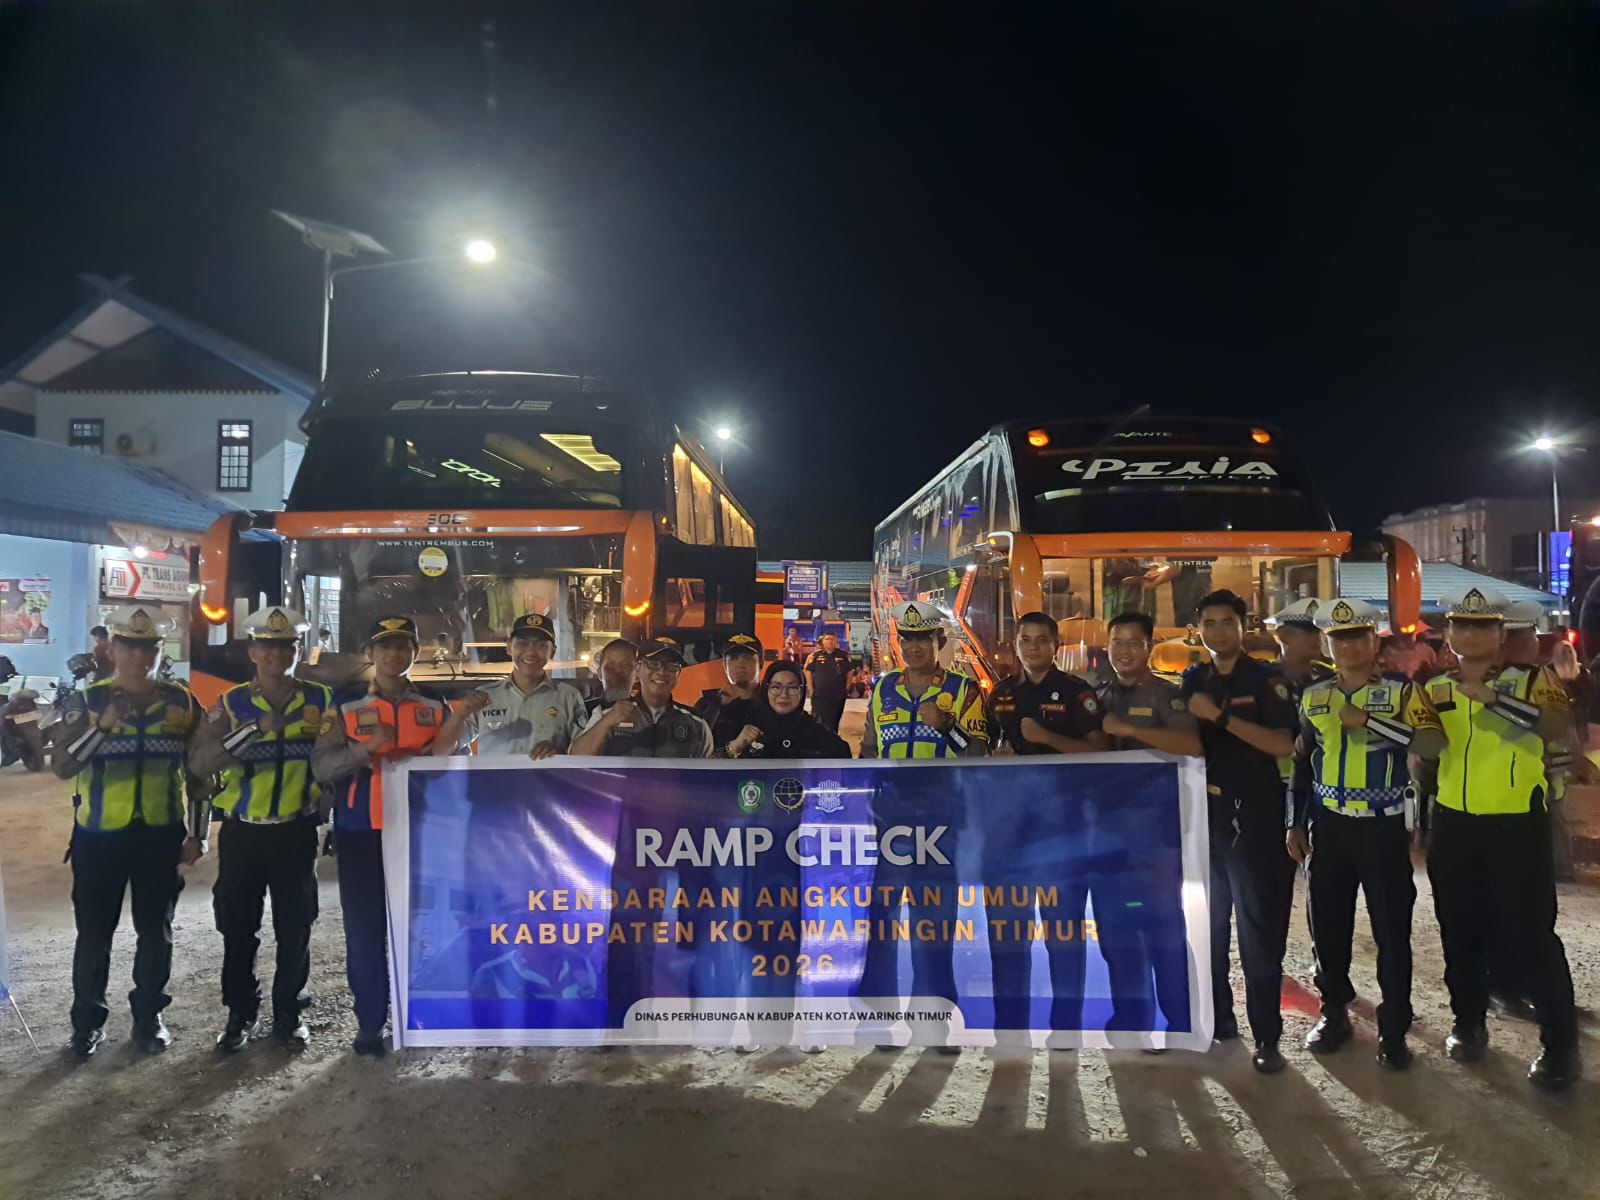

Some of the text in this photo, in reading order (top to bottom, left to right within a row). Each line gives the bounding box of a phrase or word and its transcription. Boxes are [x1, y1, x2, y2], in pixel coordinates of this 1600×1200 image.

[482, 709, 507, 717] VICKY
[636, 825, 952, 868] RAMP CHECK
[528, 885, 1059, 911] KENDARAAN ANGKUTAN UMUM
[490, 918, 1100, 945] KABUPATEN KOTAWARINGIN TIMUR
[751, 953, 835, 977] 2026
[635, 1010, 953, 1022] DINAS PERHUBUNGAN KABUPATEN KOTAWARINGIN TIMUR
